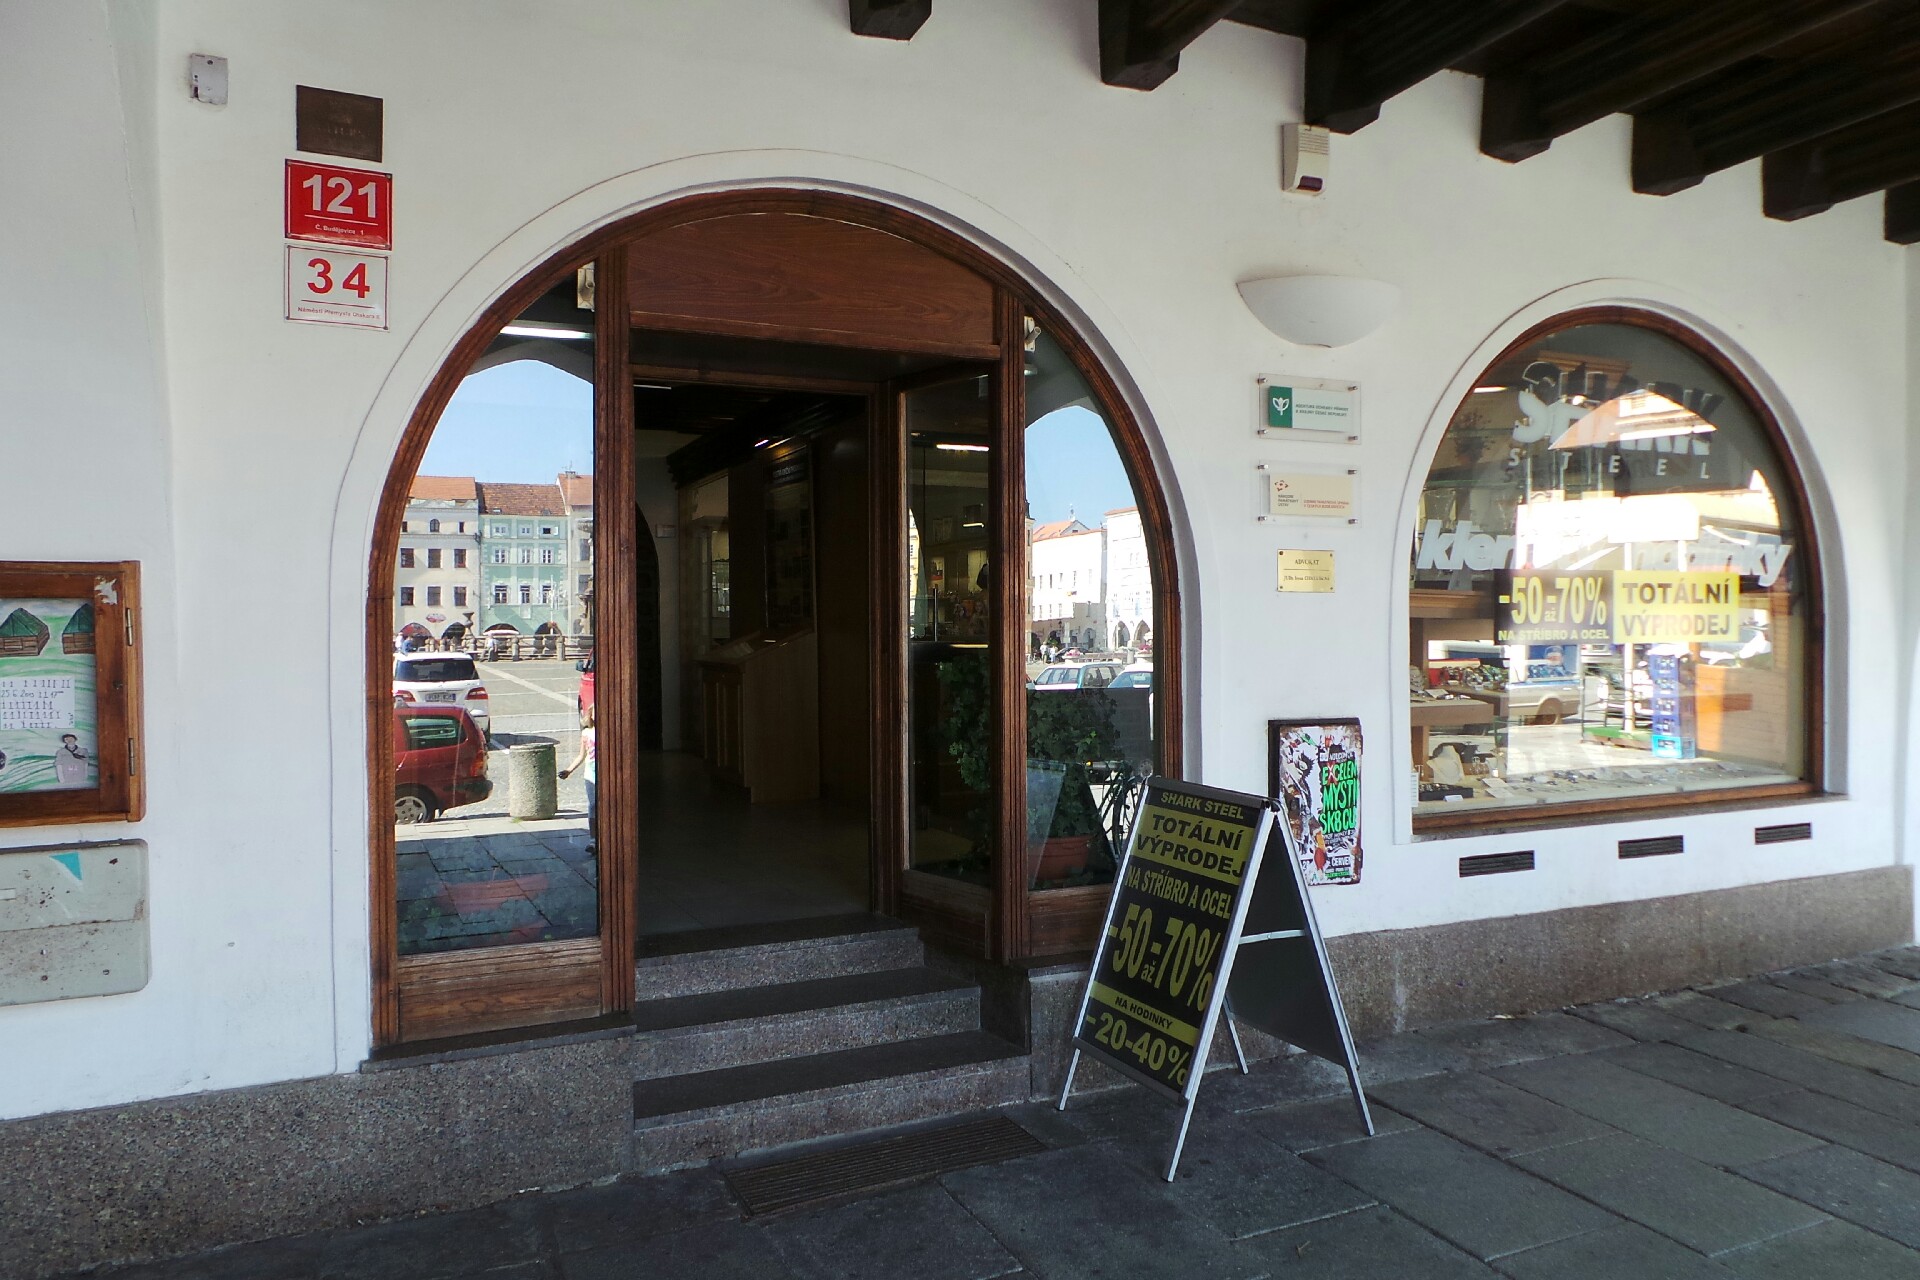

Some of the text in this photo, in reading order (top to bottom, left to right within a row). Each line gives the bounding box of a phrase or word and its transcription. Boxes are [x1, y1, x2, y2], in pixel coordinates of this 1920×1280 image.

[302, 173, 377, 219] 121
[306, 257, 372, 299] 34
[1498, 576, 1543, 625] -50
[1546, 577, 1608, 626] -70%
[1622, 577, 1731, 604] TOTÁLNÍ
[1498, 626, 1610, 641] NA STŘÍBRO A OCEL
[1622, 609, 1731, 637] VÝPRODEJ
[1160, 791, 1244, 820] SHARK STEEL
[1152, 813, 1245, 851] TOTÁLNÍ
[1137, 833, 1247, 878] VÝPRODEJ
[1124, 865, 1232, 920] NA STŘÍBRO A OCEL
[1114, 996, 1174, 1030] NA HODINKY
